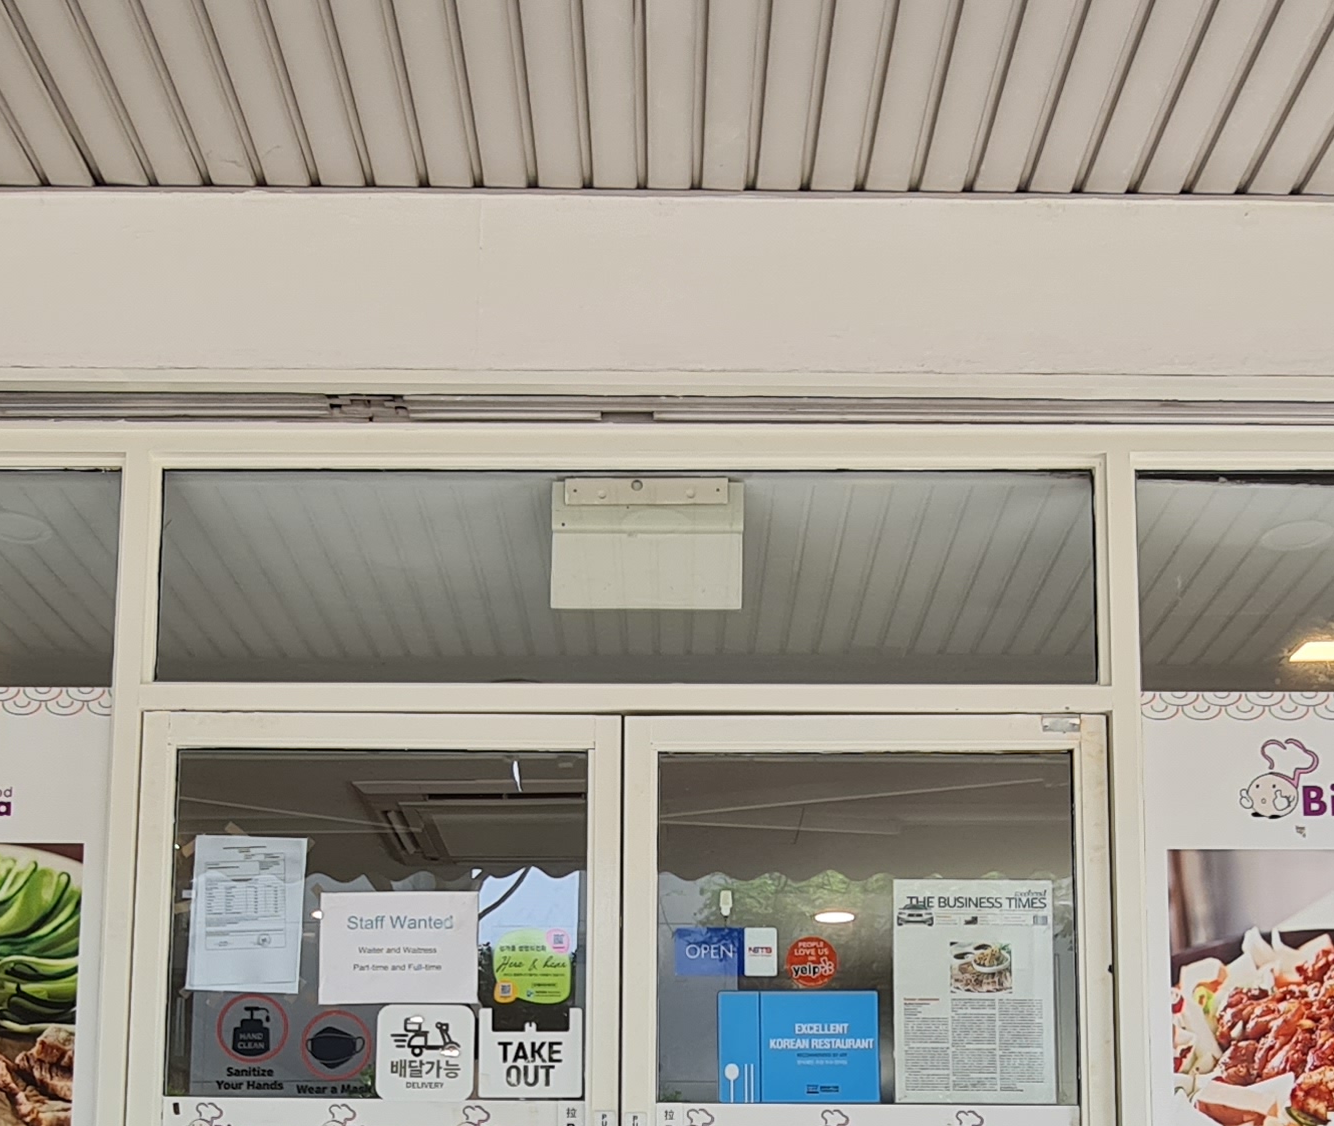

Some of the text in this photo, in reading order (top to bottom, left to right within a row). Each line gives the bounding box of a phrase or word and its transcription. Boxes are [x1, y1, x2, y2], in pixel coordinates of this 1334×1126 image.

[906, 896, 1047, 909] THE BUSINESS TIMES
[347, 915, 454, 930] Staff Wanted
[358, 946, 437, 954] Waiter and Waitress
[685, 944, 734, 959] OPEN
[794, 948, 829, 956] LOVE US
[792, 963, 821, 979] yelp
[795, 1023, 849, 1034] EXCELLENT
[239, 1032, 263, 1040] HAND
[237, 1041, 265, 1049] CLEAN
[769, 1038, 874, 1049] KOREAN RESTAURANT
[498, 1041, 563, 1063] TAKE
[226, 1066, 274, 1077] Sanitize
[390, 1059, 461, 1079] 배달가능
[505, 1065, 555, 1087] OUT
[216, 1080, 284, 1091] Your Hands
[296, 1084, 327, 1095] Wear
[330, 1087, 338, 1095] a
[405, 1081, 444, 1089] DELIVERY
[566, 1107, 577, 1118] 拉
[664, 1109, 674, 1120] 拉
